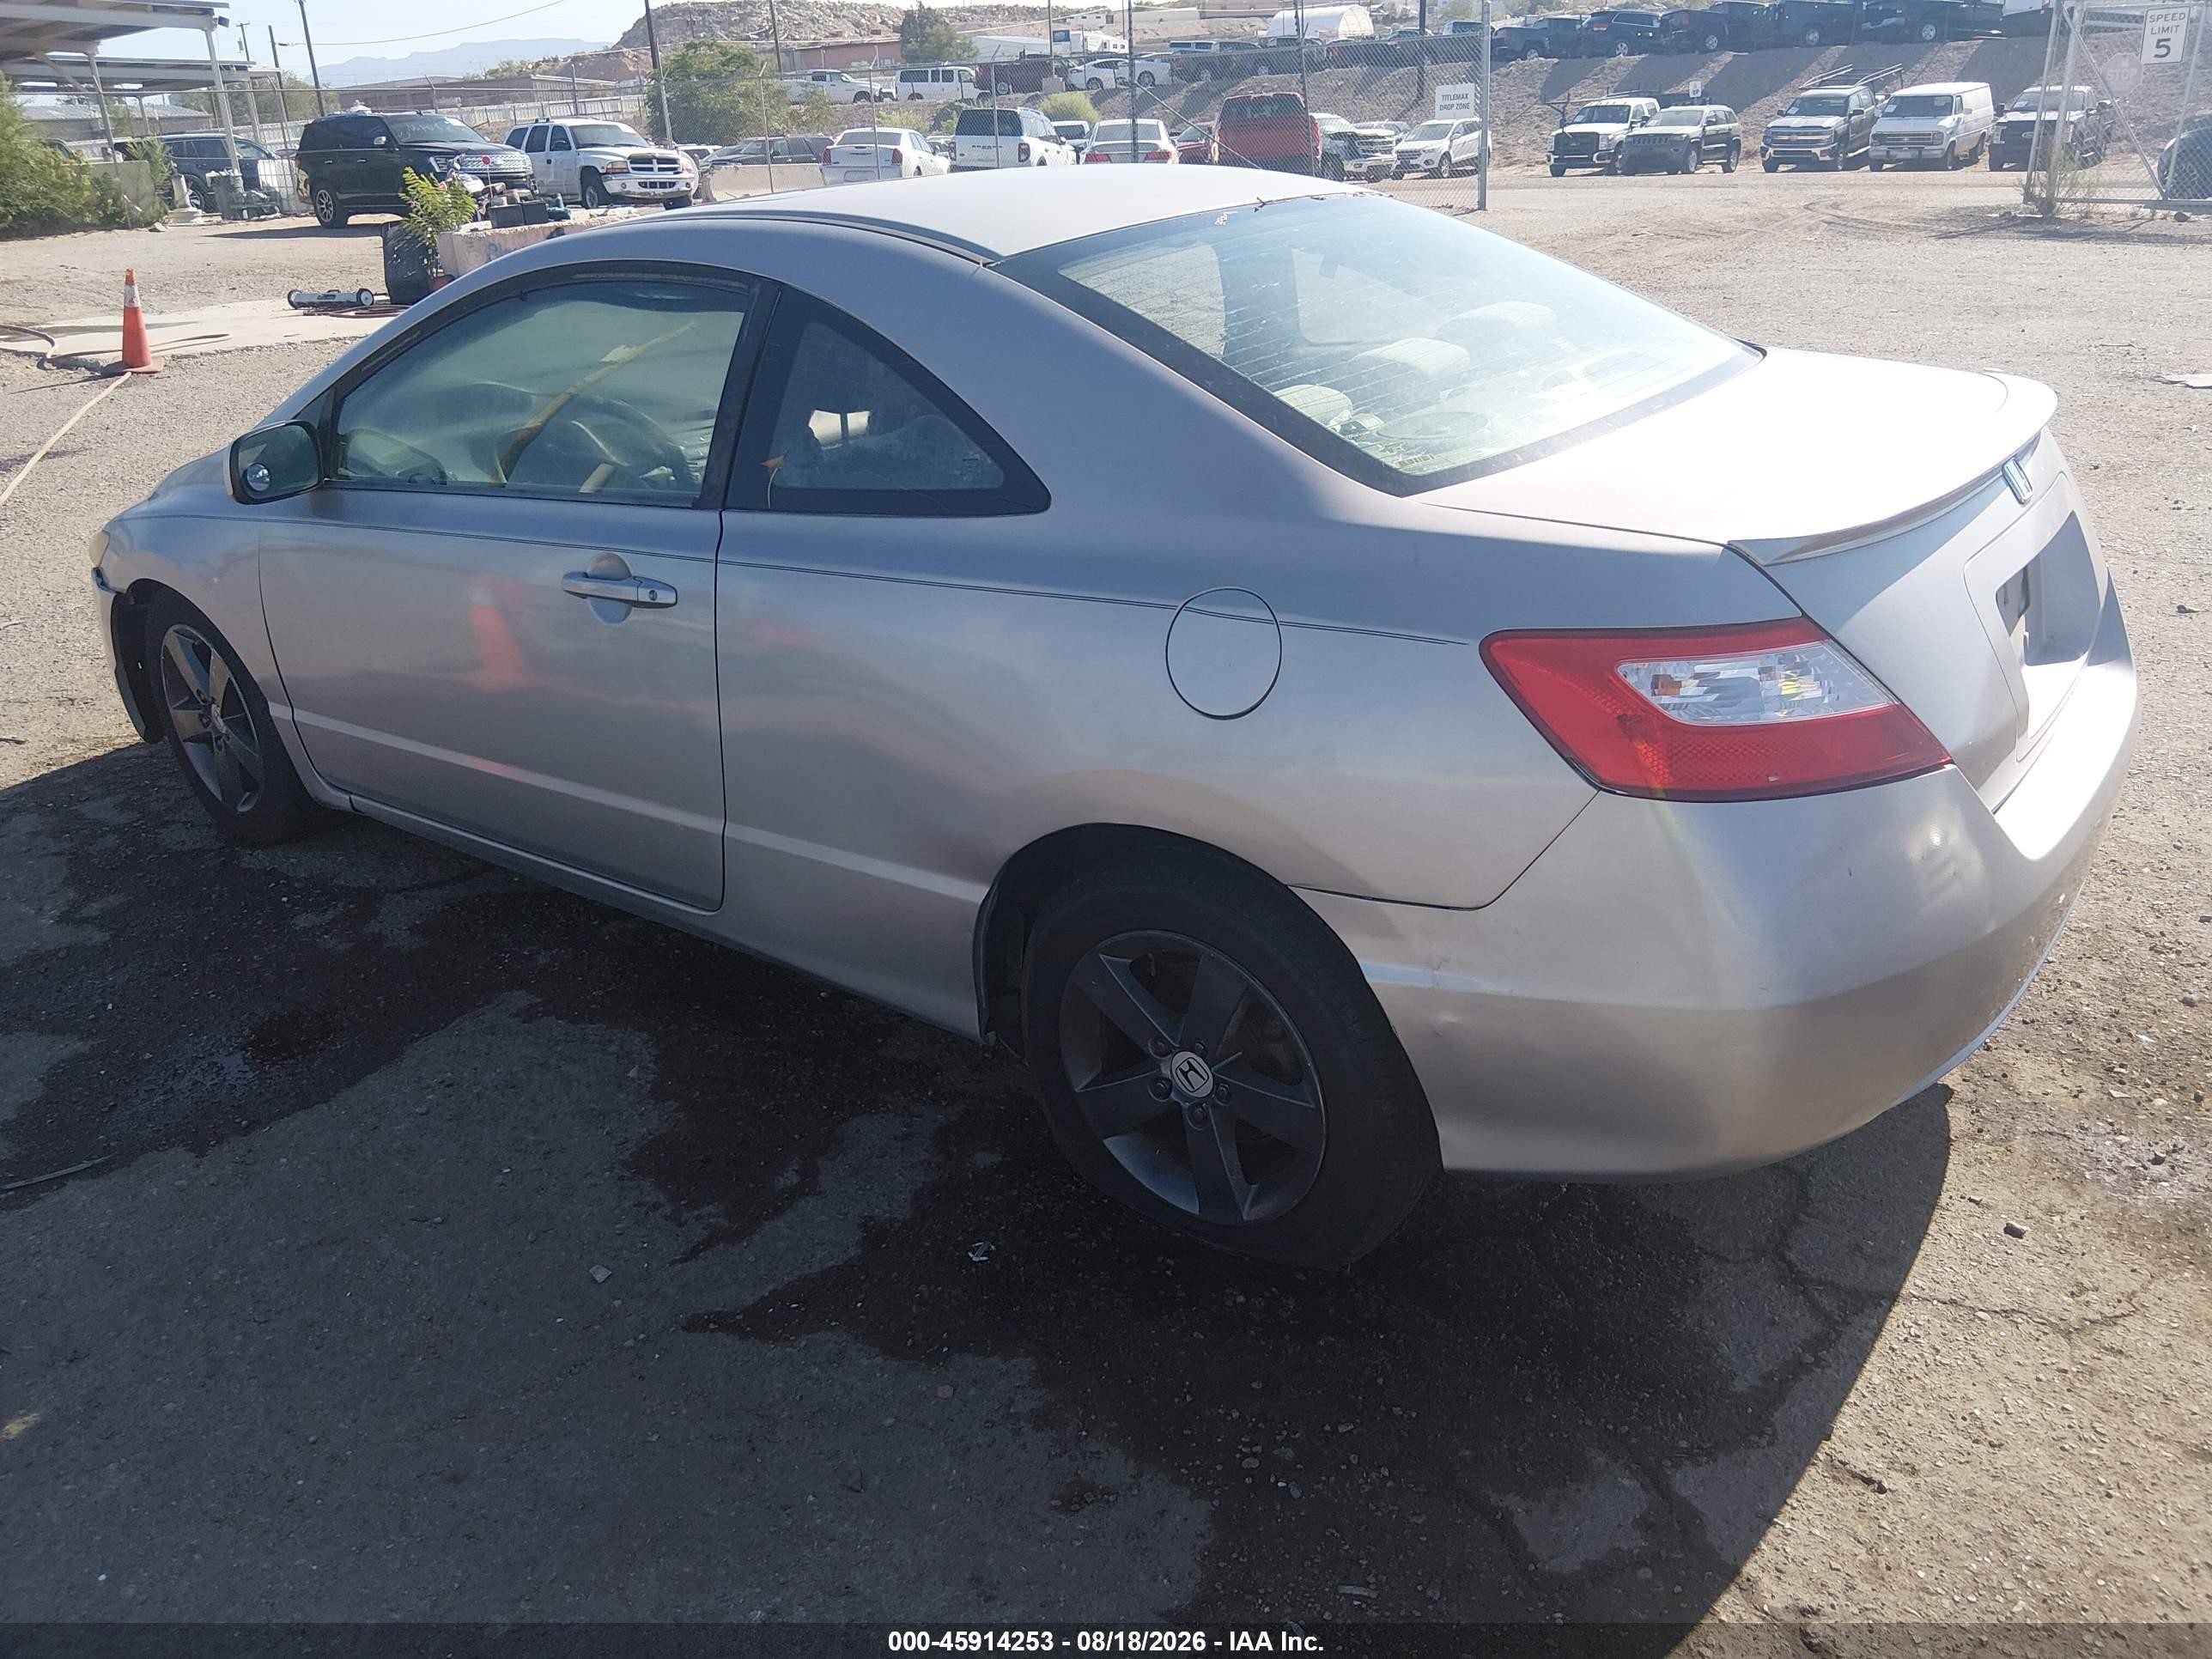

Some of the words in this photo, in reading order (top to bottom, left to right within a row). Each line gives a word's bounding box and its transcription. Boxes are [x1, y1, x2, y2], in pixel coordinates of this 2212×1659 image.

[2148, 12, 2185, 23] SPEED
[2150, 25, 2180, 35] LIMIT
[2154, 38, 2171, 58] 5
[2107, 68, 2138, 82] STOP
[1439, 103, 1455, 112] DROP
[1455, 102, 1471, 111] ZONE
